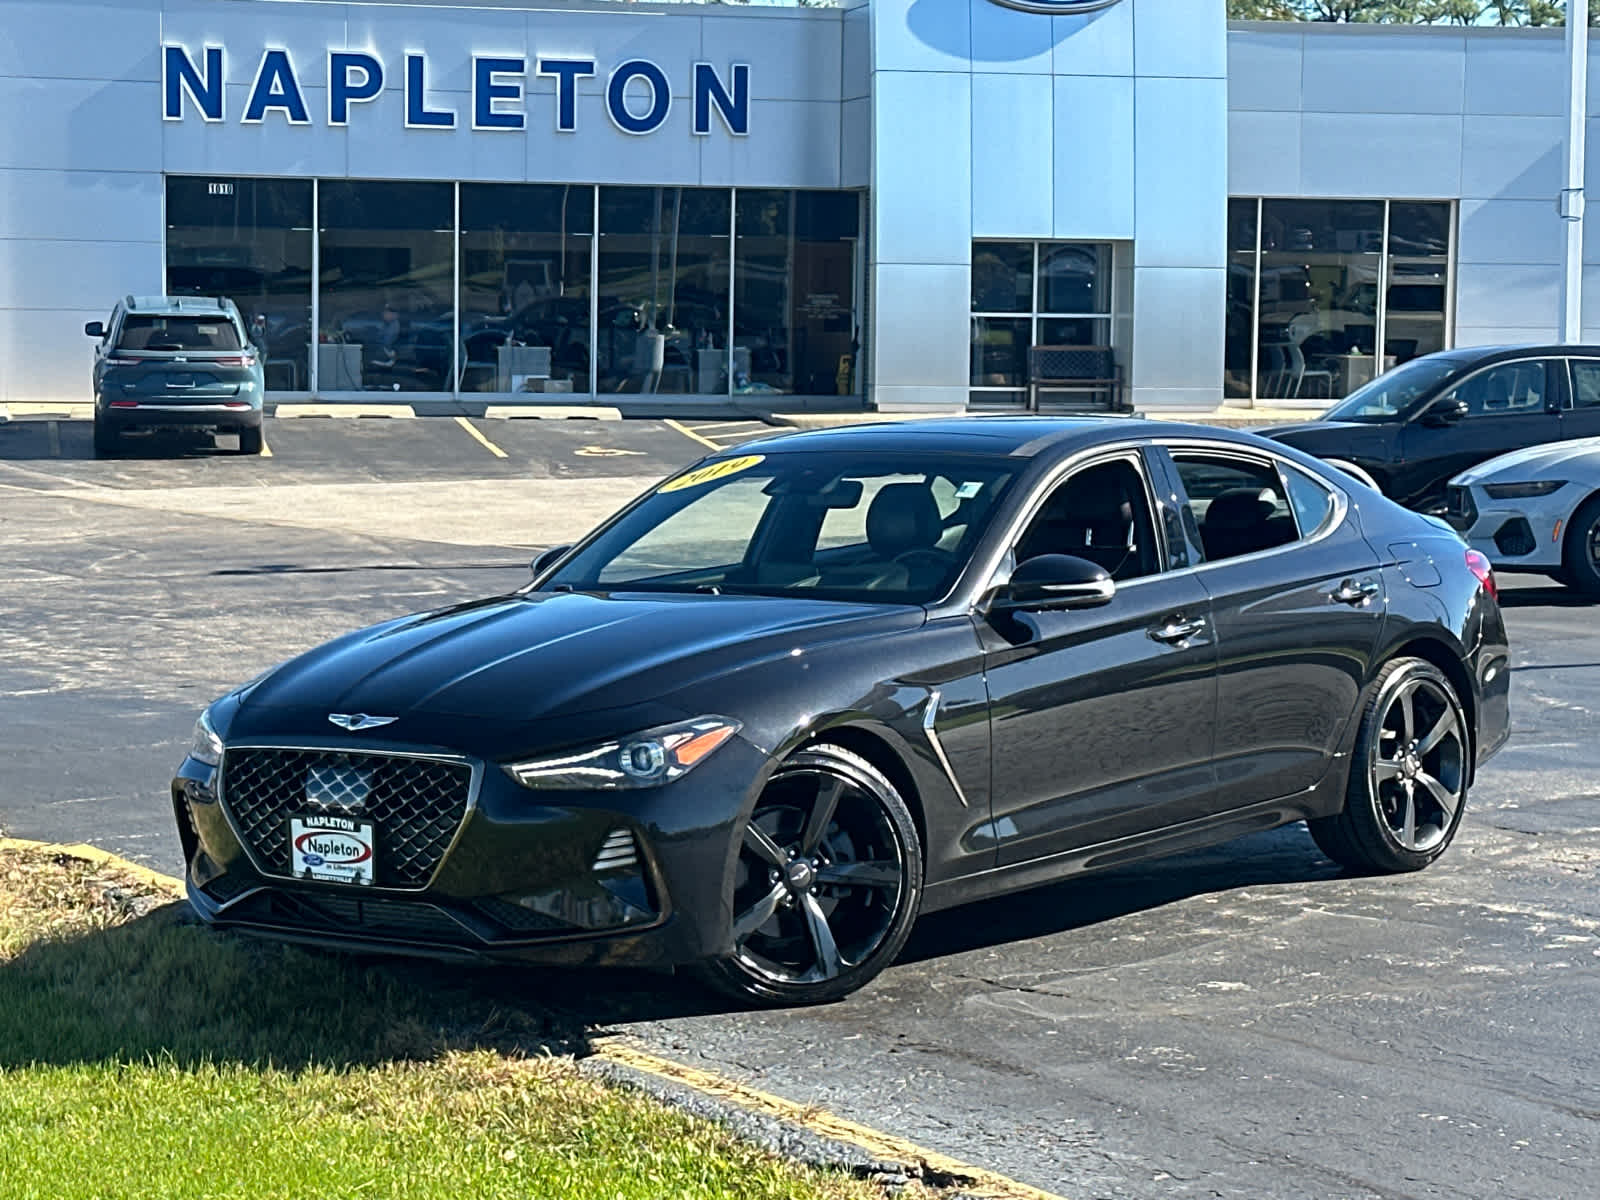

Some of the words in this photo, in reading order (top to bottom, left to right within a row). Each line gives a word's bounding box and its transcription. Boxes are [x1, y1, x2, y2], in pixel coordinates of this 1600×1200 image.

[161, 42, 751, 136] NAPLETON
[306, 816, 354, 831] NAPLETON
[308, 838, 359, 857] Napleton
